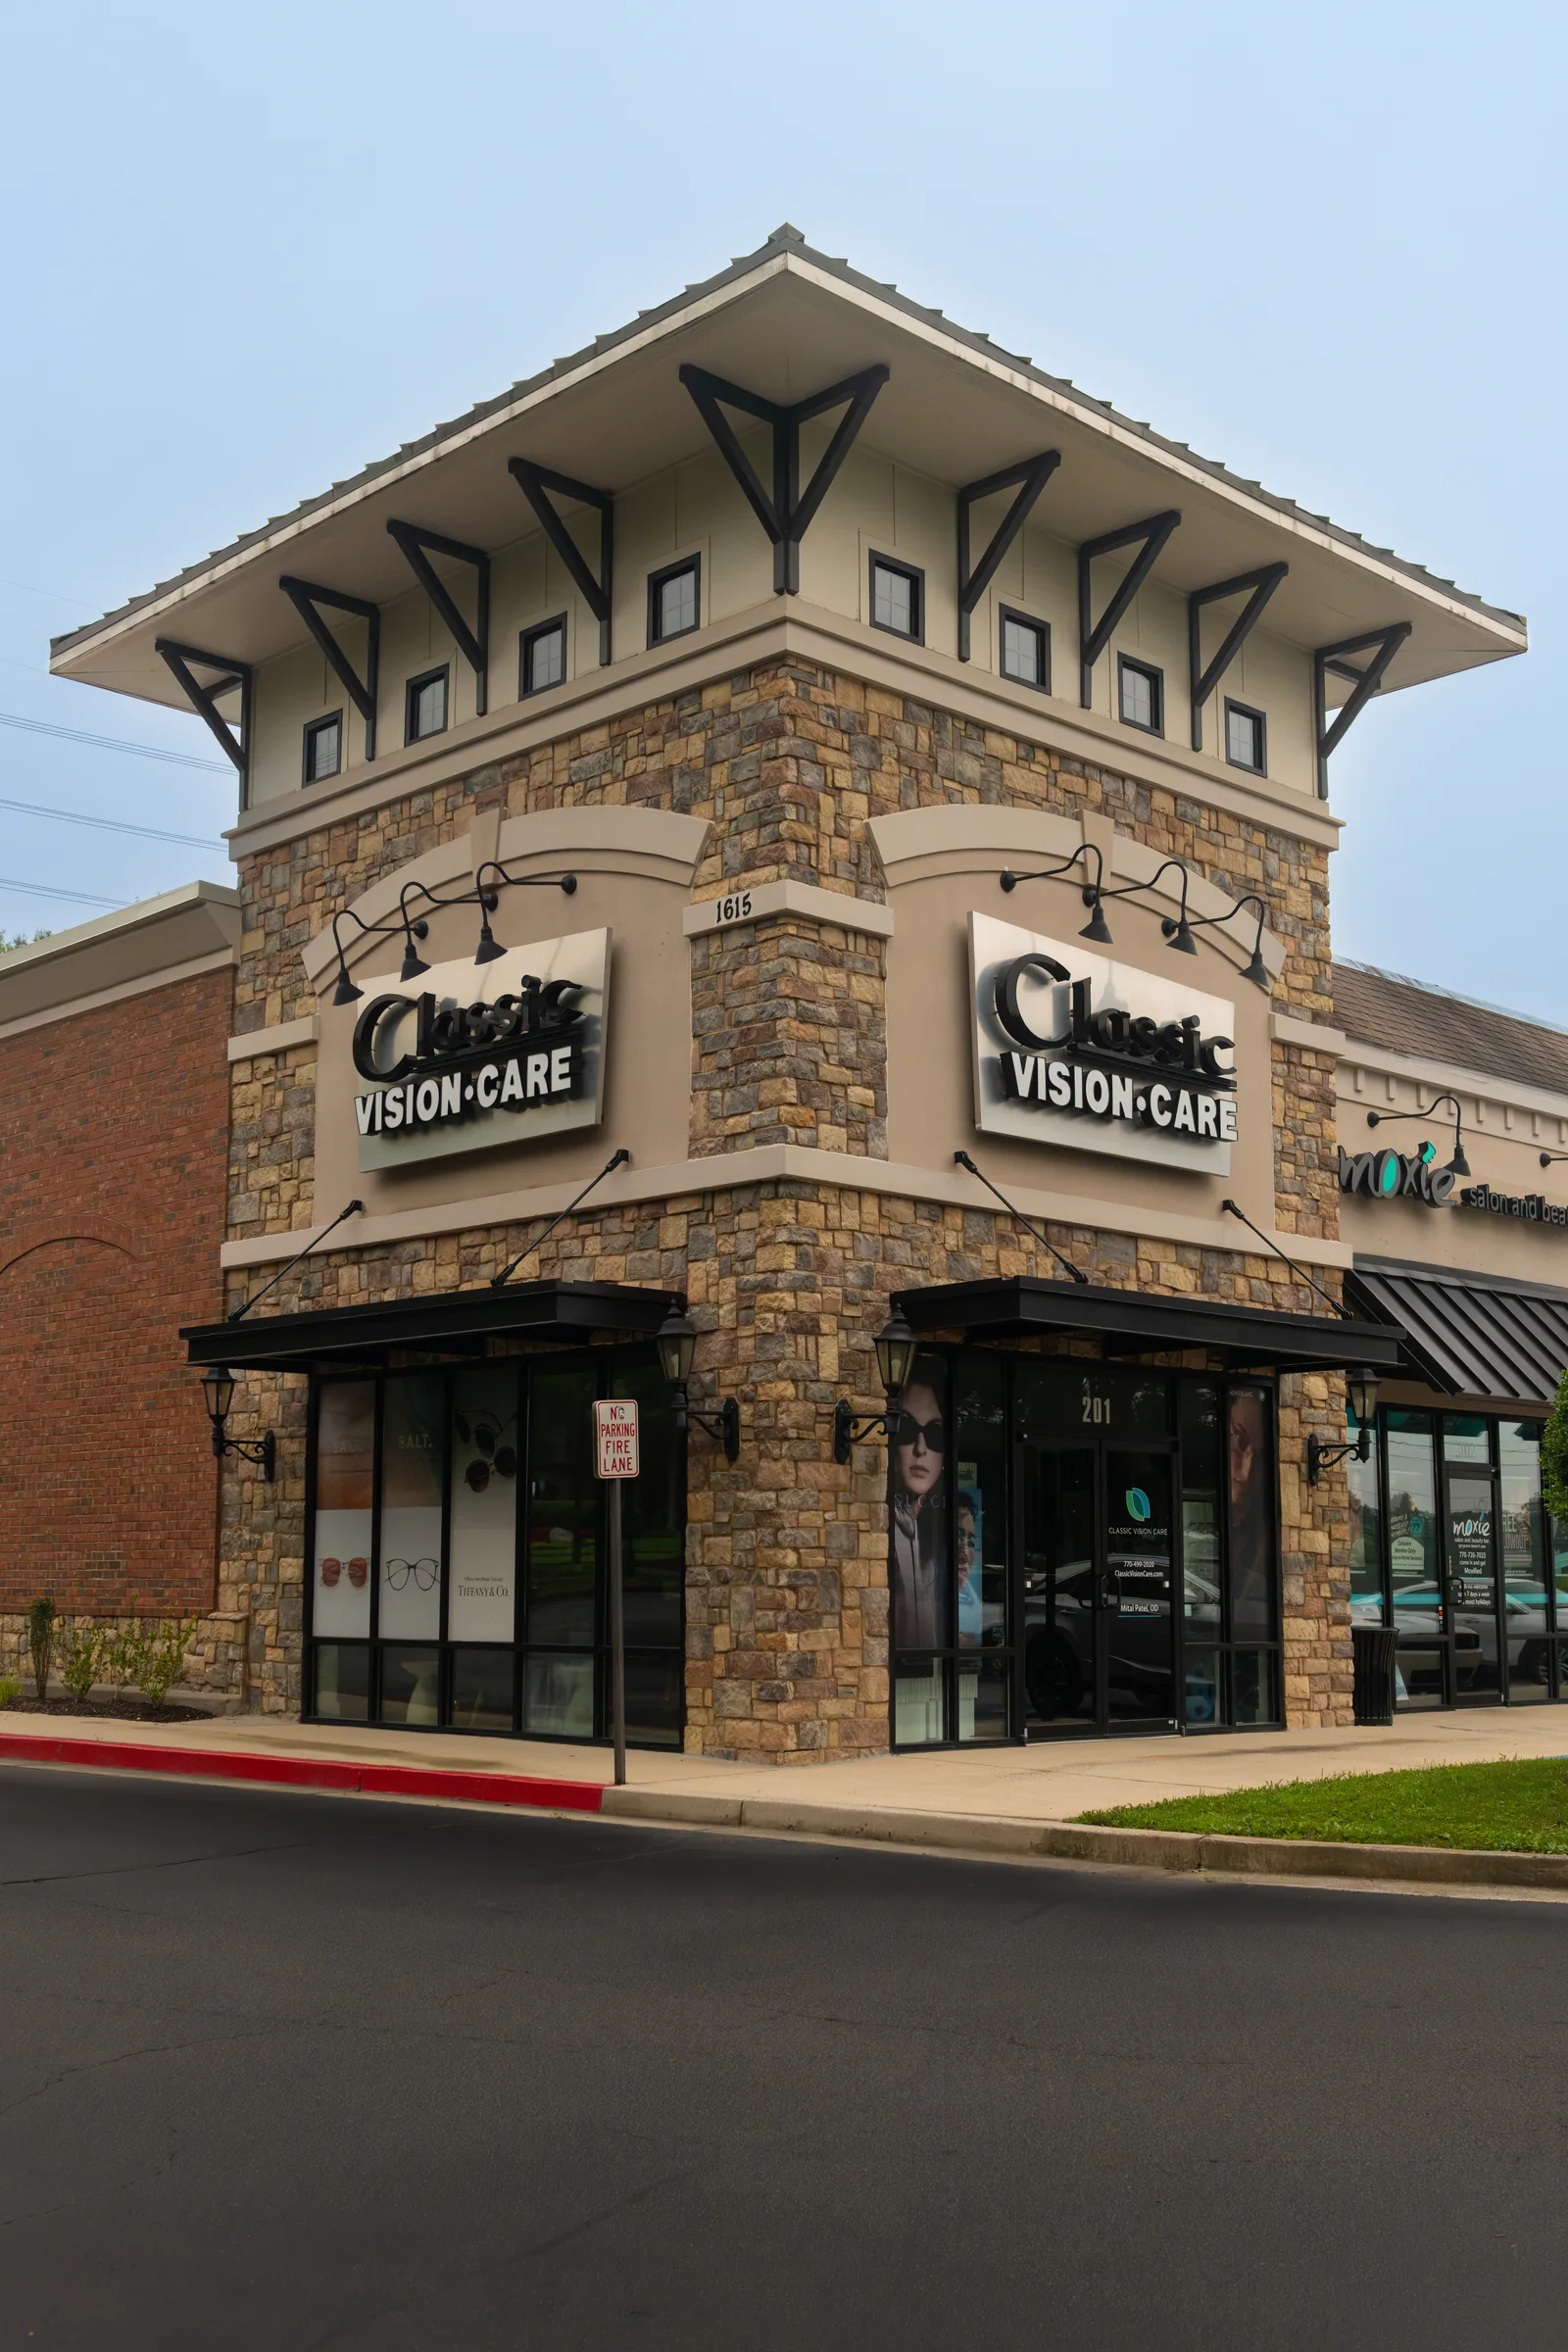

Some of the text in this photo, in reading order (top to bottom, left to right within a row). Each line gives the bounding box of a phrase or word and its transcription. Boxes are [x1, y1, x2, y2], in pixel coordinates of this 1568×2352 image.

[716, 892, 752, 923] 1615
[352, 974, 584, 1082] Classic
[995, 953, 1237, 1076] Classic
[1468, 1184, 1568, 1226] salon and bea
[1082, 1396, 1110, 1424] 201
[601, 1423, 635, 1437] PARKING
[606, 1441, 630, 1454] FIRE
[604, 1457, 633, 1472] LANE
[1114, 1569, 1164, 1578] ClassicVisionCare.com
